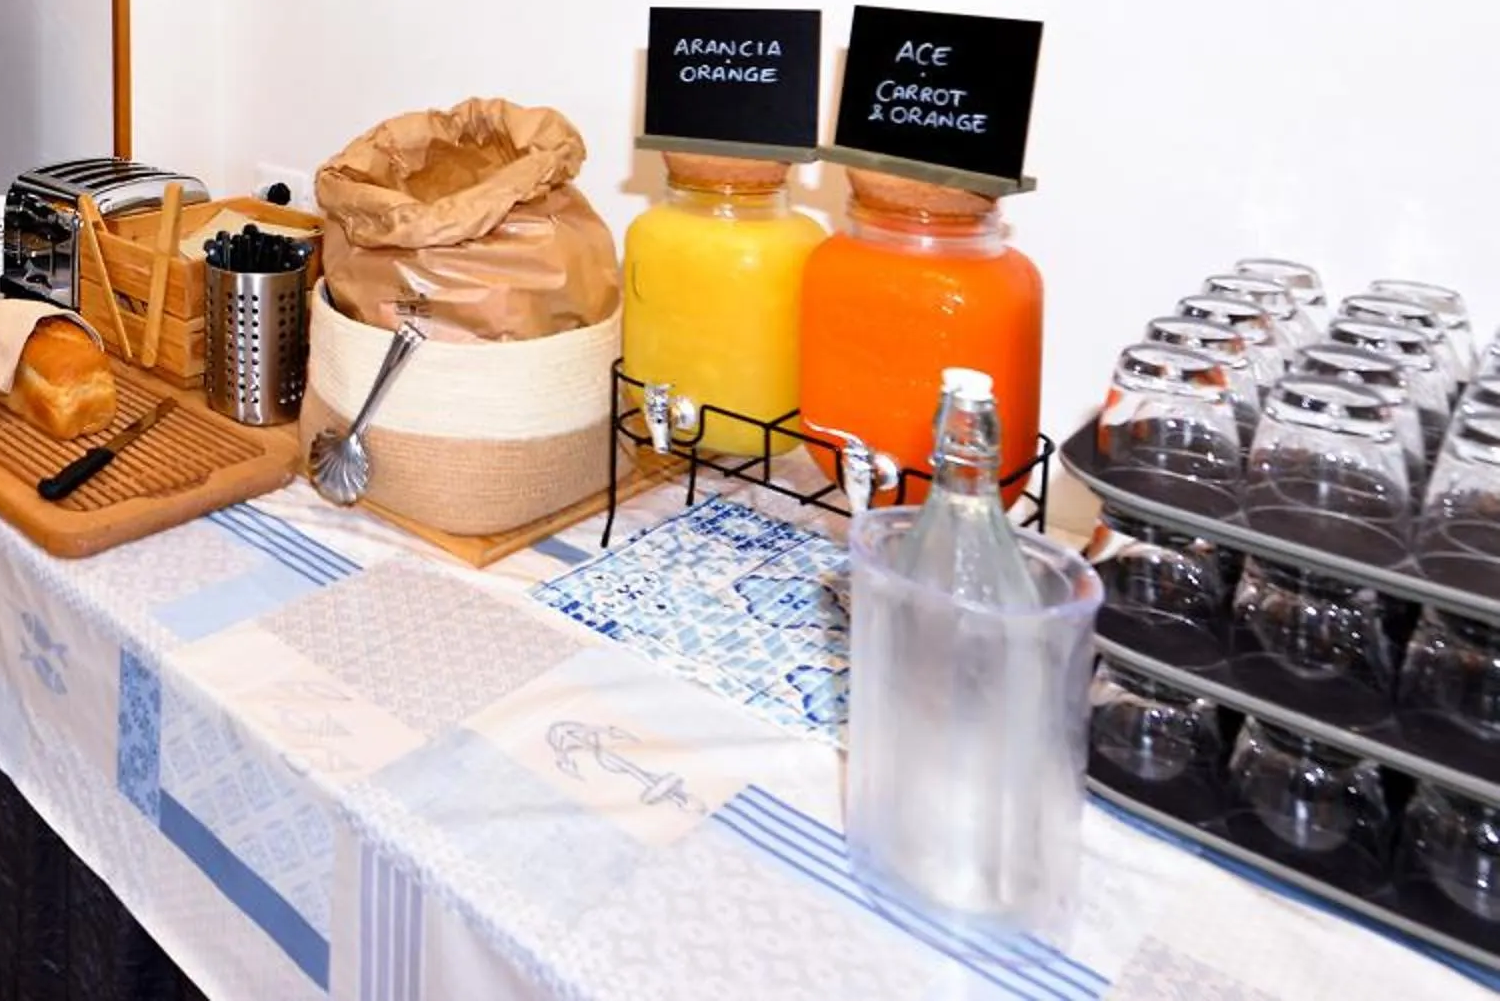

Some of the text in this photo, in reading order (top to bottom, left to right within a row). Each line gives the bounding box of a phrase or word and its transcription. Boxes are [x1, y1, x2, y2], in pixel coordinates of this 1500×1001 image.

[673, 38, 782, 58] ARANCIA
[895, 40, 953, 67] ACE
[679, 65, 779, 83] ORANGE
[875, 79, 968, 108] CARROT
[867, 104, 989, 134] & ORANGE
